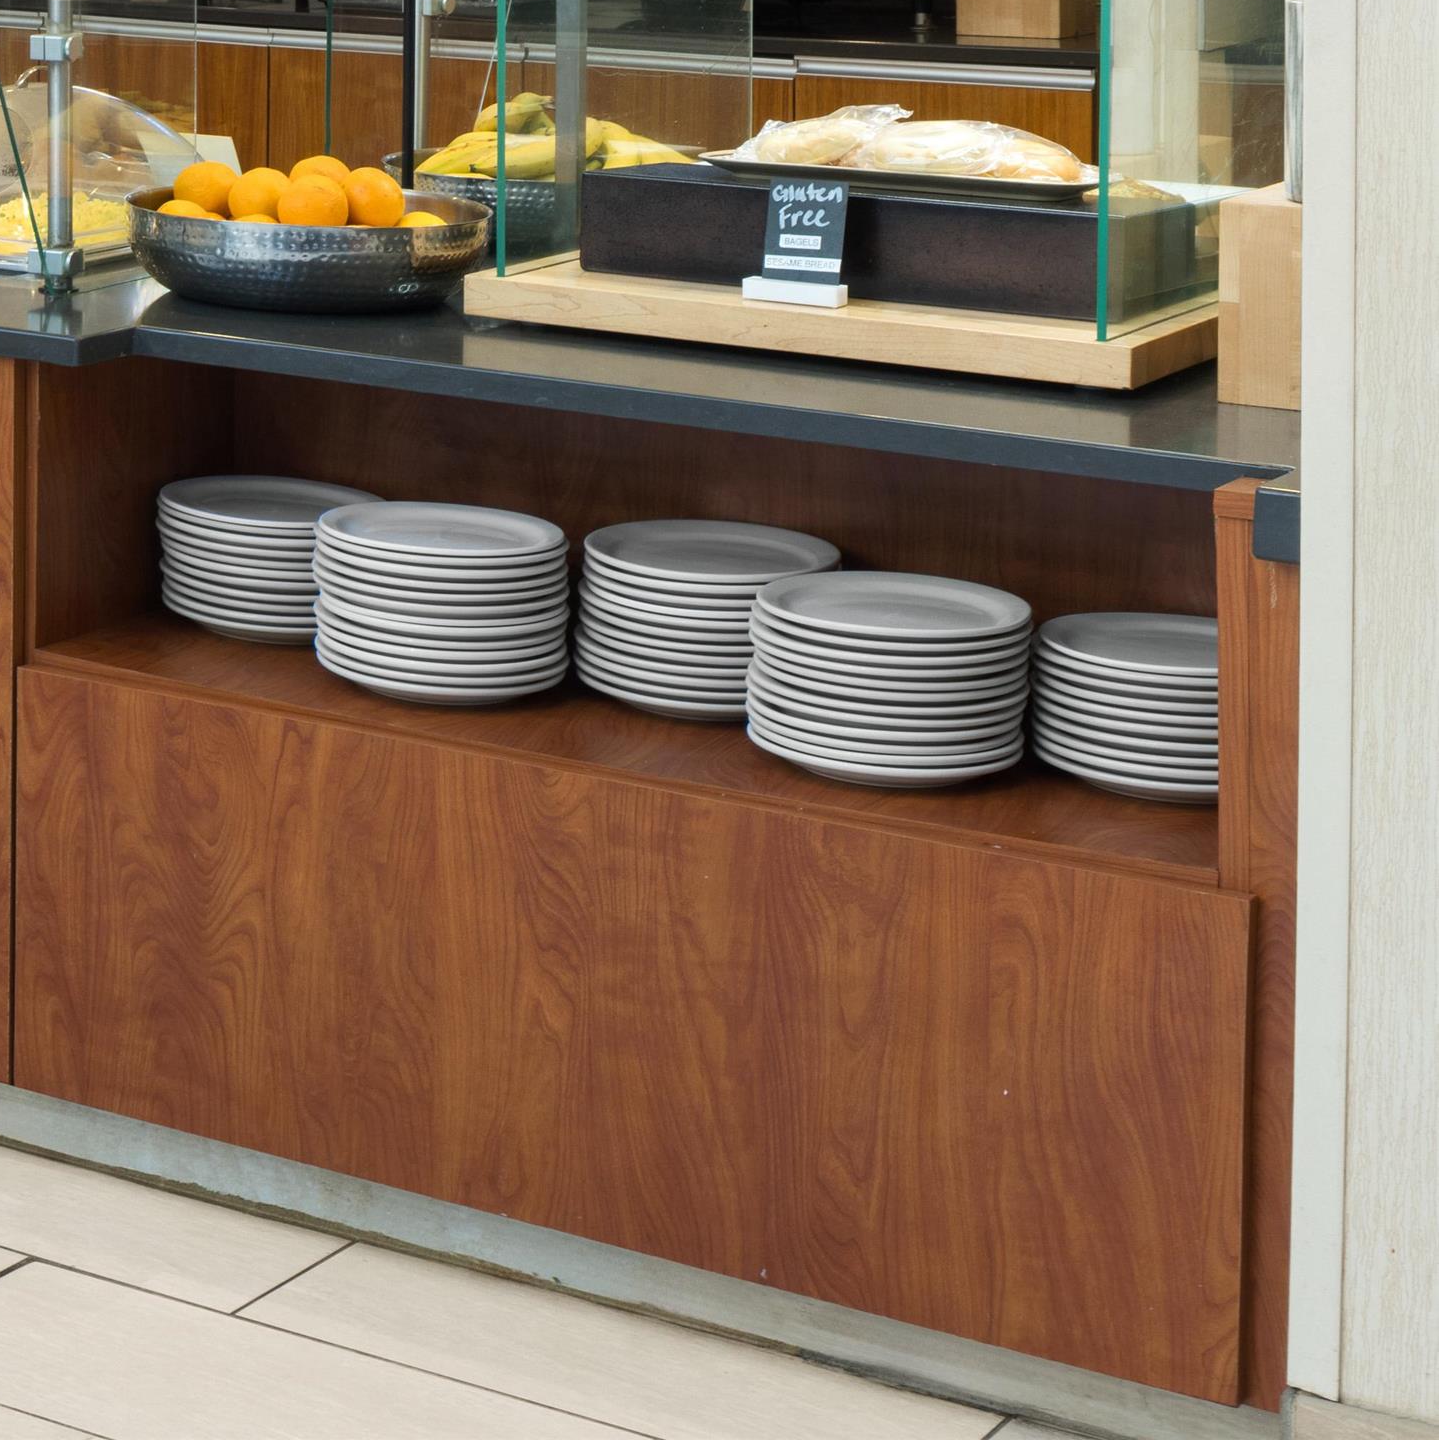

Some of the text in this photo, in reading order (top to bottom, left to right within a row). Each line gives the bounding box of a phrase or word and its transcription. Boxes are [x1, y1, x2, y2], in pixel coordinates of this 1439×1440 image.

[772, 182, 843, 203] Gluten
[778, 203, 831, 230] Free
[784, 236, 820, 247] BAGELS
[766, 257, 836, 269] SESAME BREAD
